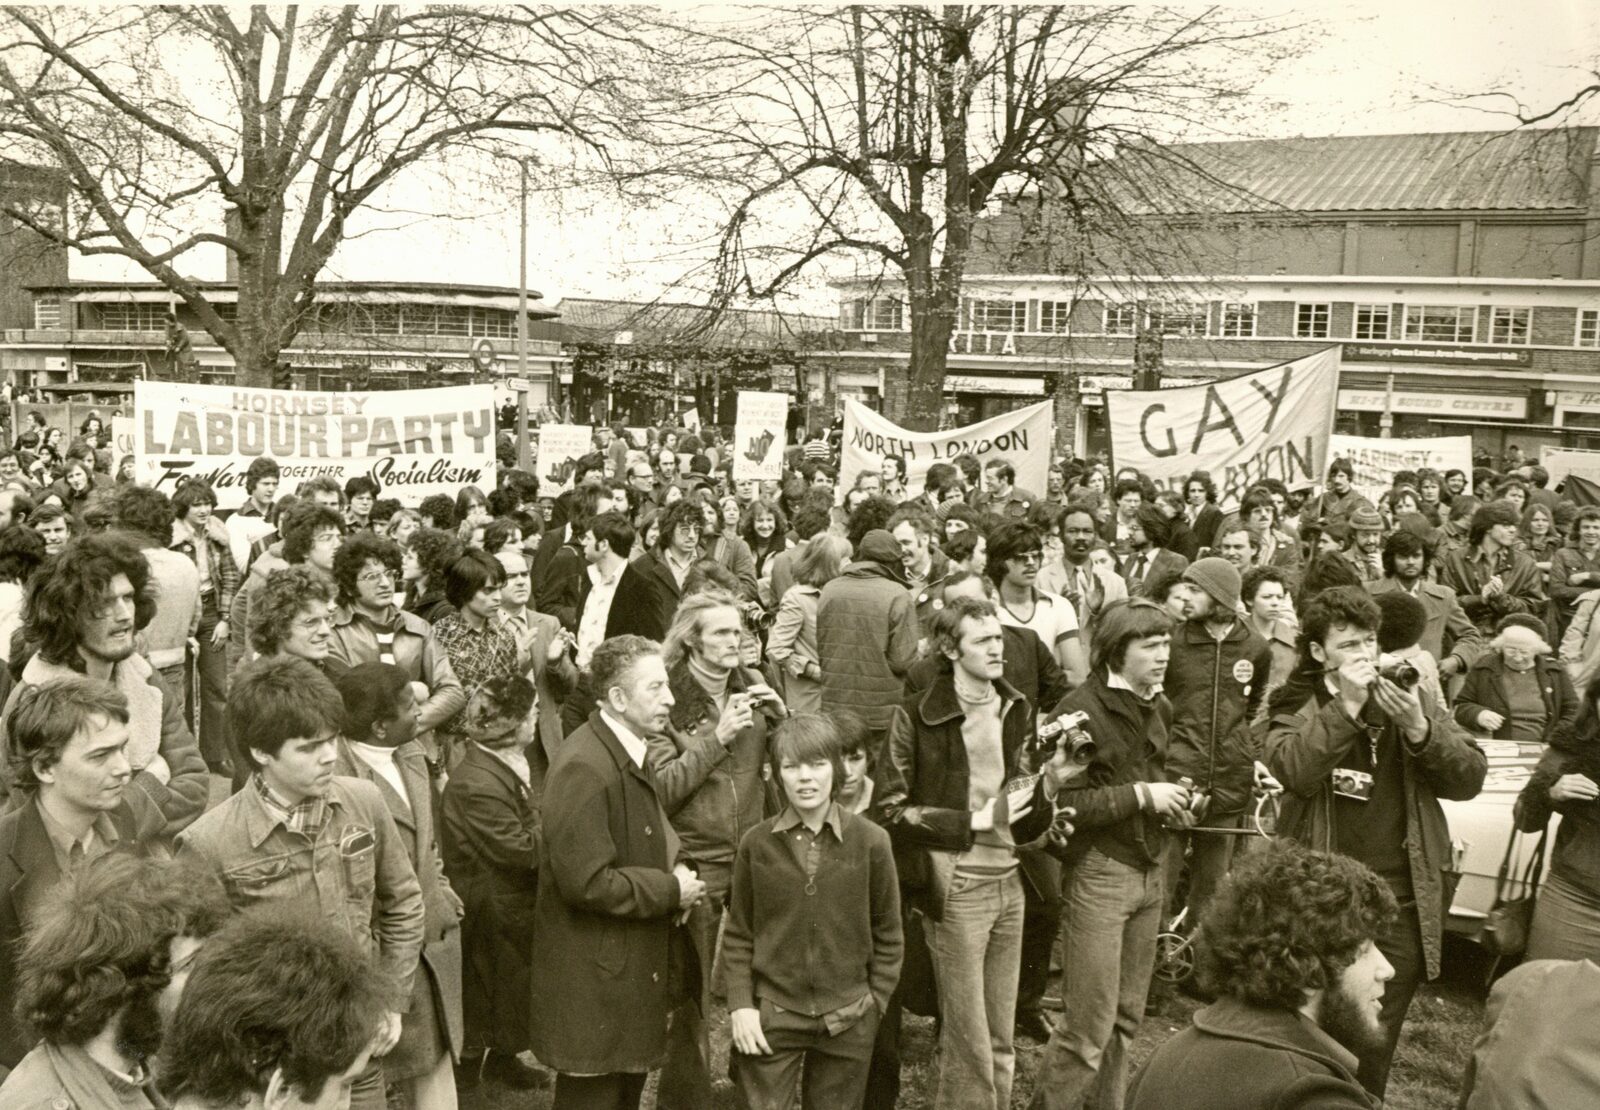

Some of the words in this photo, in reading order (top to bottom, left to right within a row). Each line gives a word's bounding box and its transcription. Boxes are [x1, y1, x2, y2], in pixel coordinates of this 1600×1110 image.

[232, 392, 369, 416] HORNSEY
[1140, 367, 1293, 458] GAY
[1452, 399, 1515, 412] CENTRE
[144, 410, 329, 457] LABOUR
[341, 409, 491, 457] PARTY
[850, 426, 915, 460] NORTH
[931, 428, 1029, 460] LONDON
[748, 436, 770, 457] NO
[279, 465, 344, 478] TOGETHER
